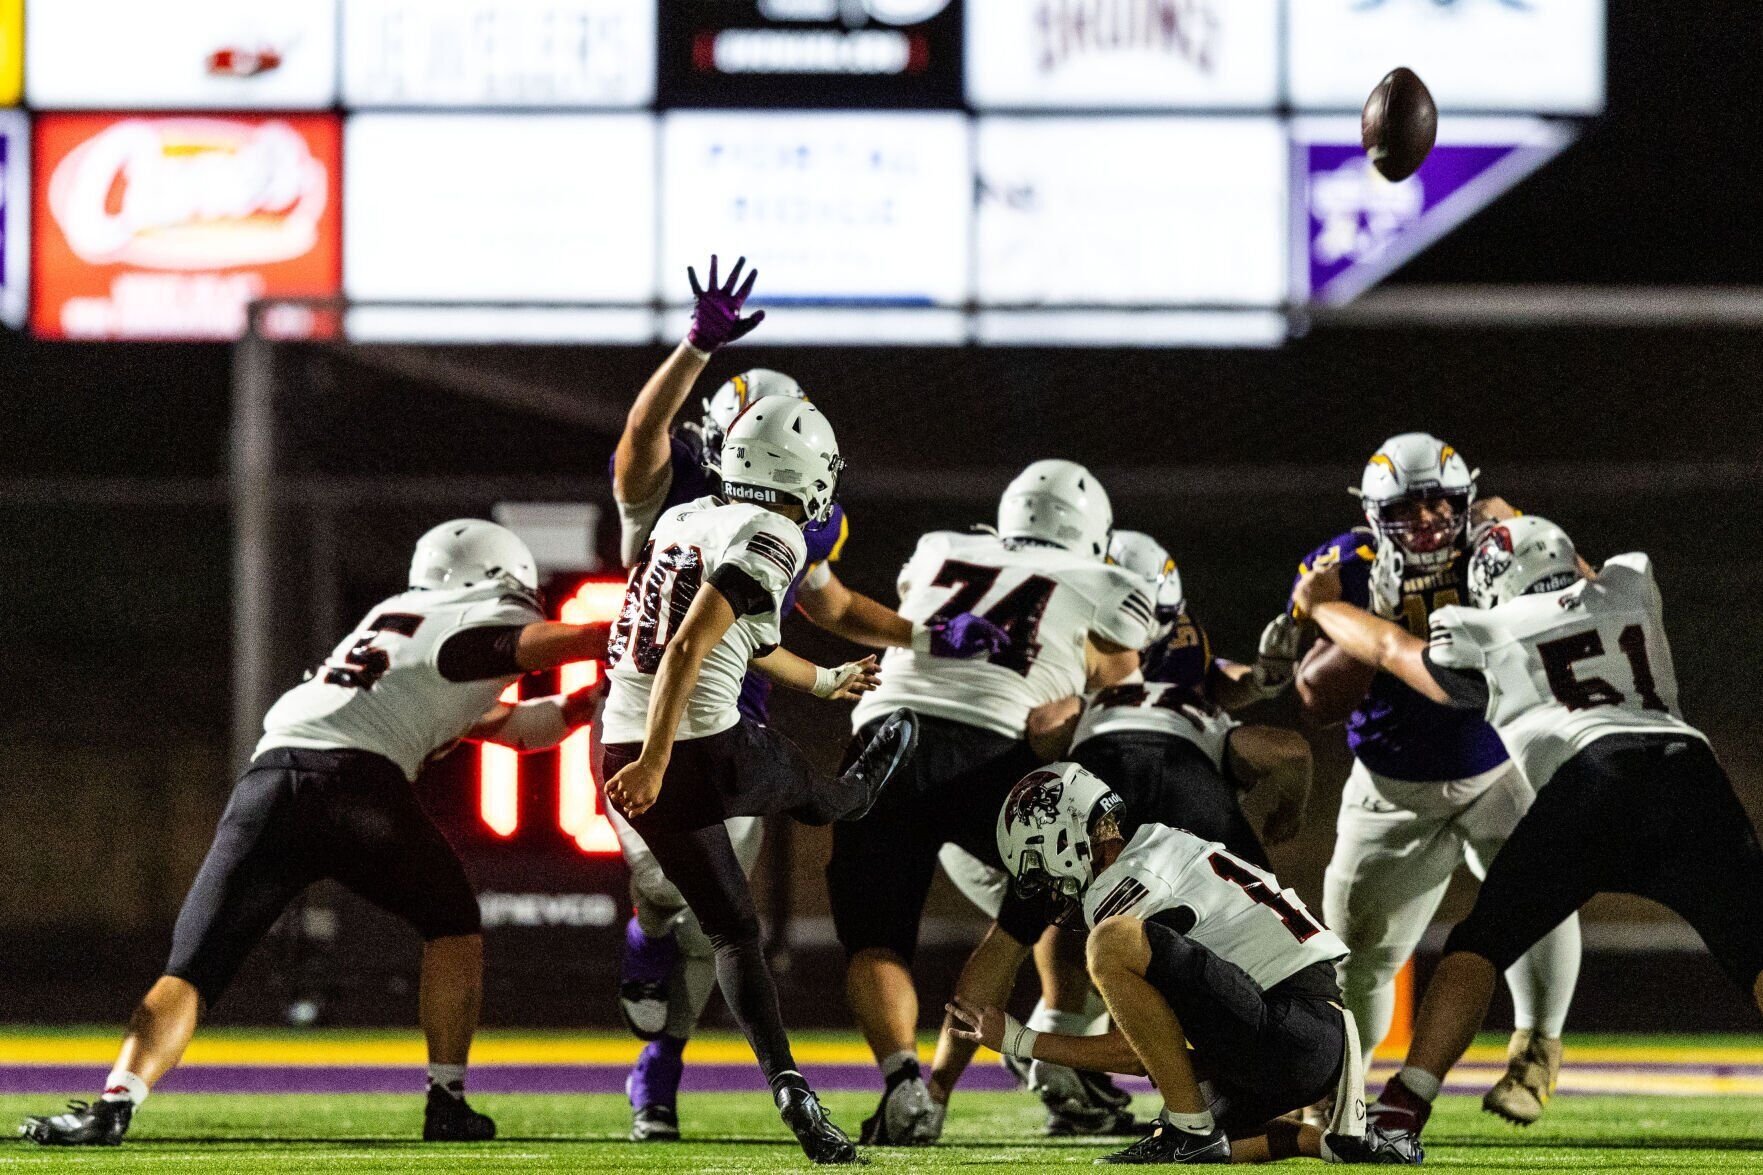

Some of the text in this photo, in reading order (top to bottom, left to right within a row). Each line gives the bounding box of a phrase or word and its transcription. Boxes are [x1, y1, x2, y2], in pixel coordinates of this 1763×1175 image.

[725, 482, 776, 503] Riddell
[926, 559, 1058, 679] 74
[1536, 623, 1670, 713] 51
